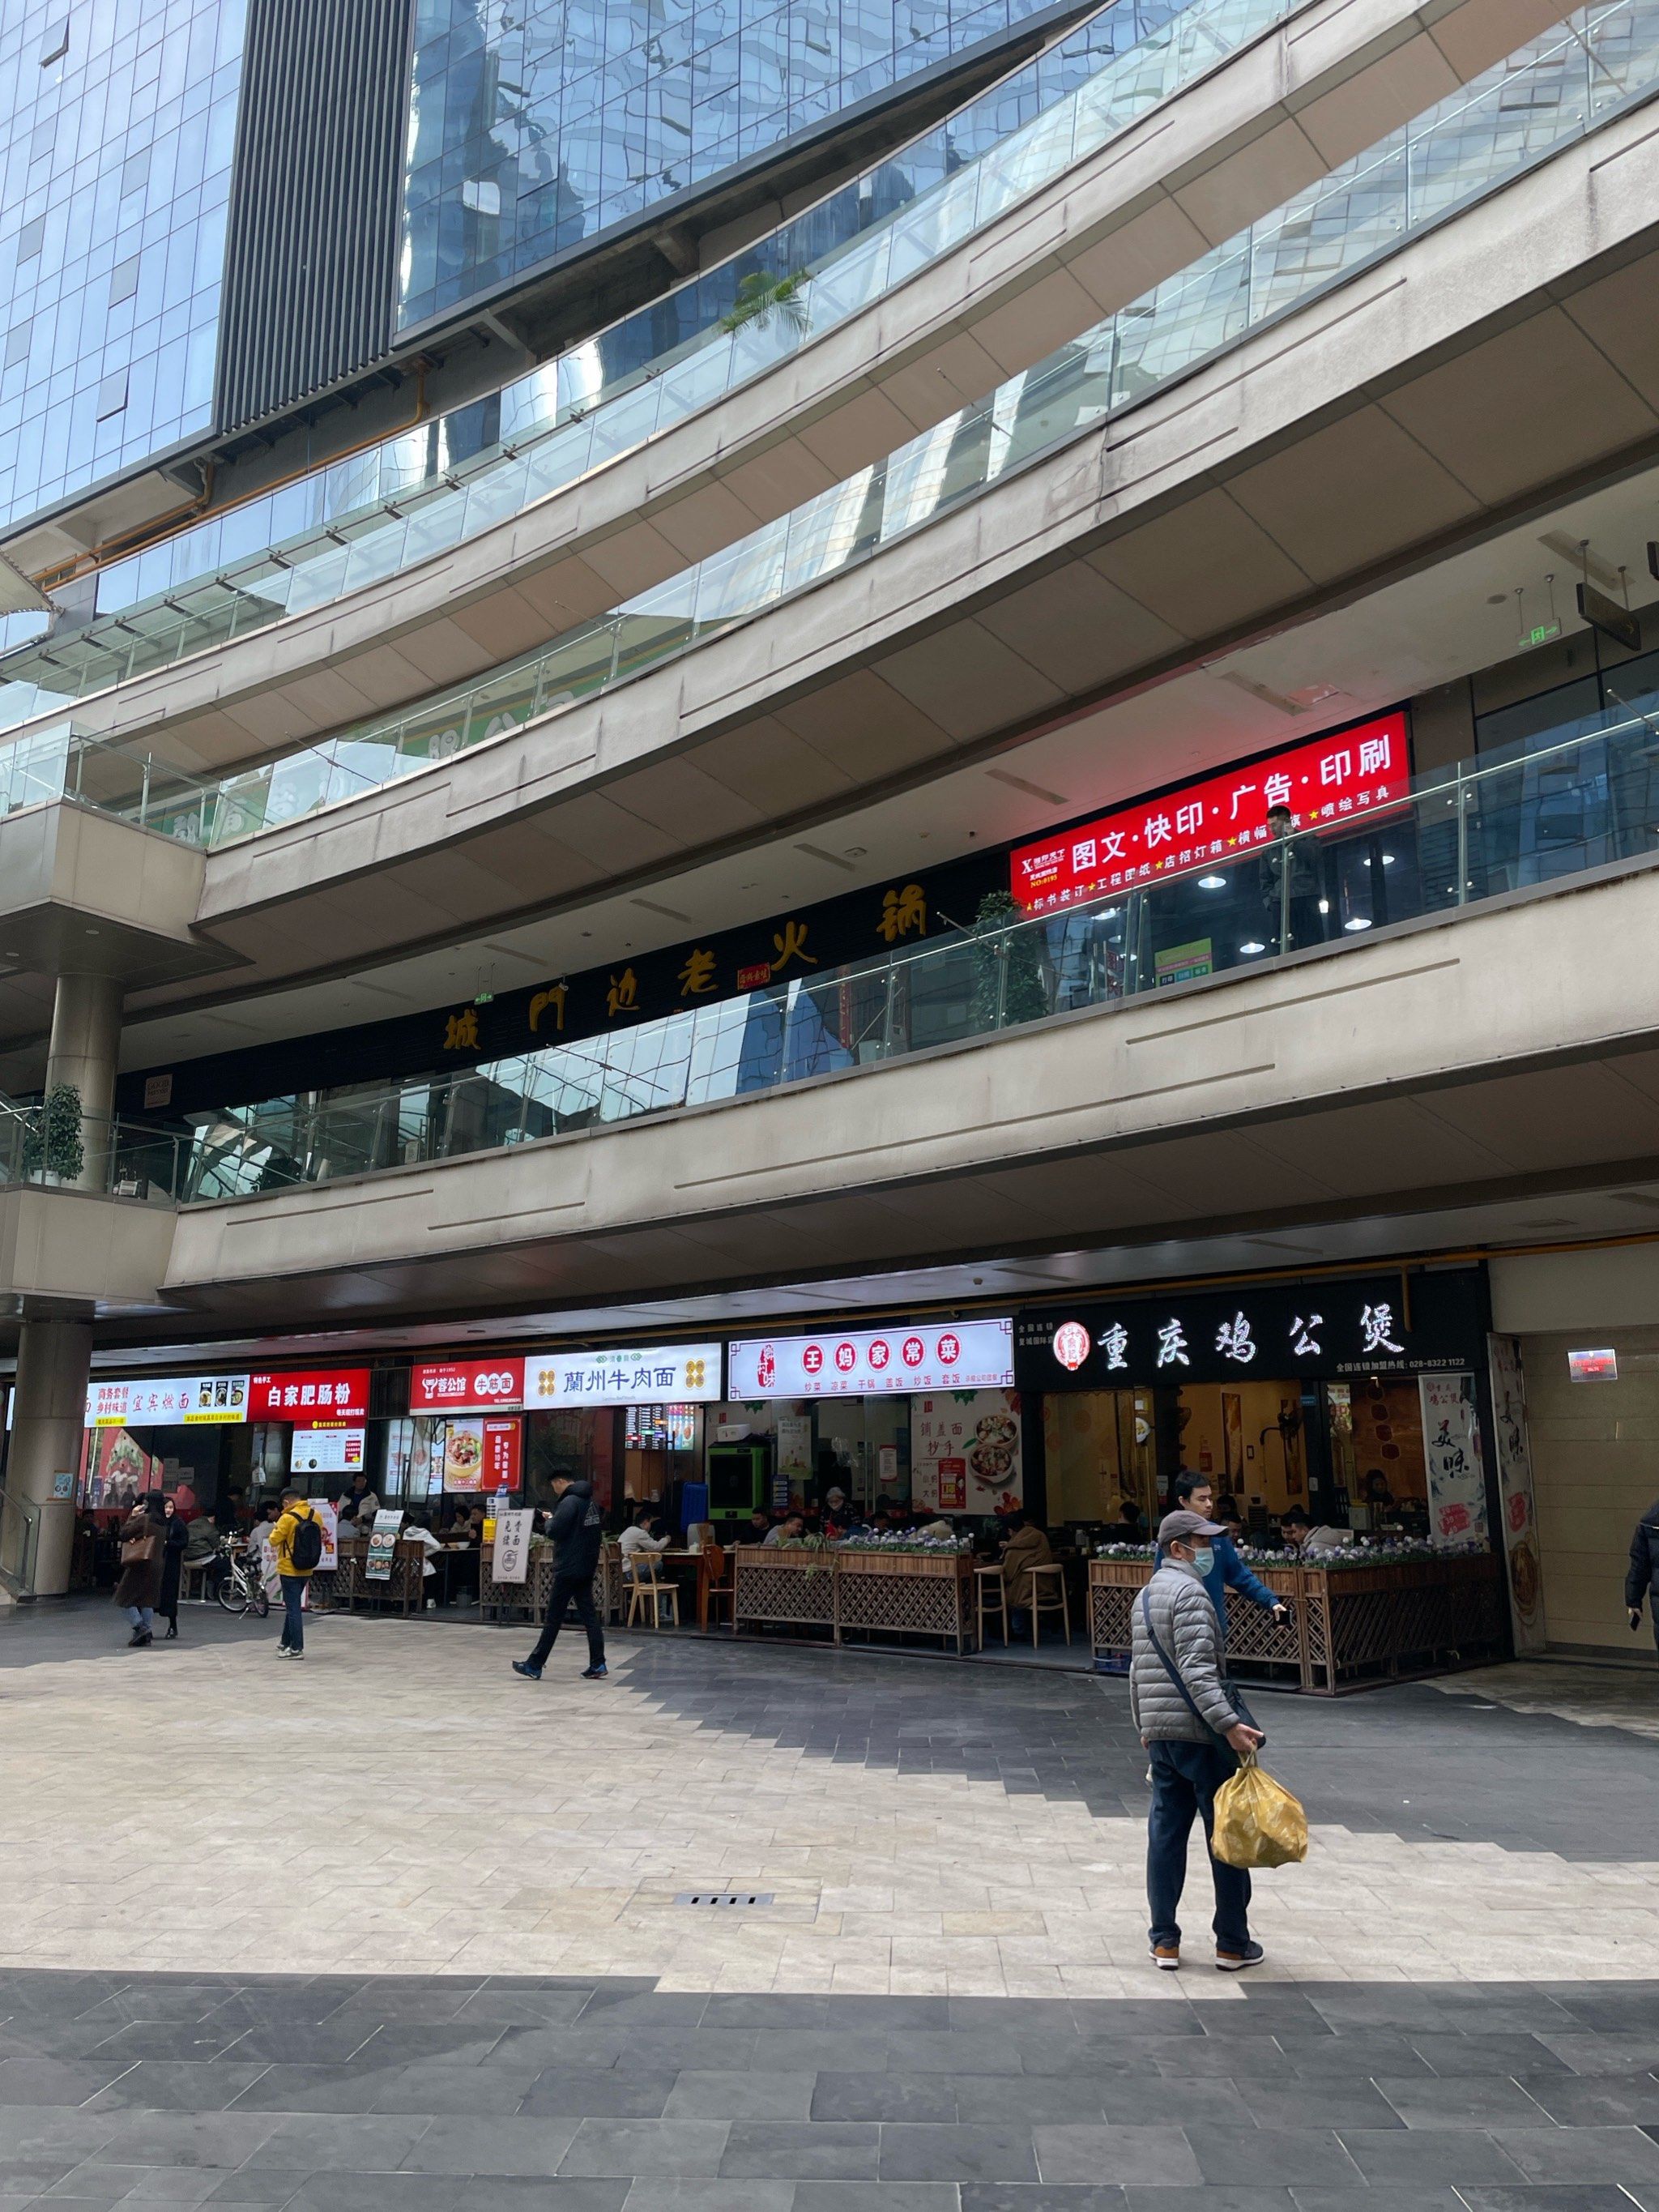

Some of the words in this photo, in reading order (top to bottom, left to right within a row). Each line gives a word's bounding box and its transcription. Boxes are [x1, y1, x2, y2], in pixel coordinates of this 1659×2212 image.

[1034, 885, 1085, 911] 标书装订
[1098, 862, 1150, 890] 工程图纸
[1165, 839, 1222, 869] 店招灯箱
[1239, 814, 1301, 844] 横幅旗
[1321, 785, 1389, 818] 喷绘写真
[1098, 1302, 1405, 1370] 重庆鸡公煲
[805, 1338, 962, 1369] 王妈家常菜
[98, 1386, 129, 1400] 商务套餐
[268, 1382, 351, 1407] 白家肥肠粉
[830, 1381, 847, 1390] 凉菜
[914, 1375, 932, 1386] 炒饭
[942, 1373, 961, 1384] 套饭
